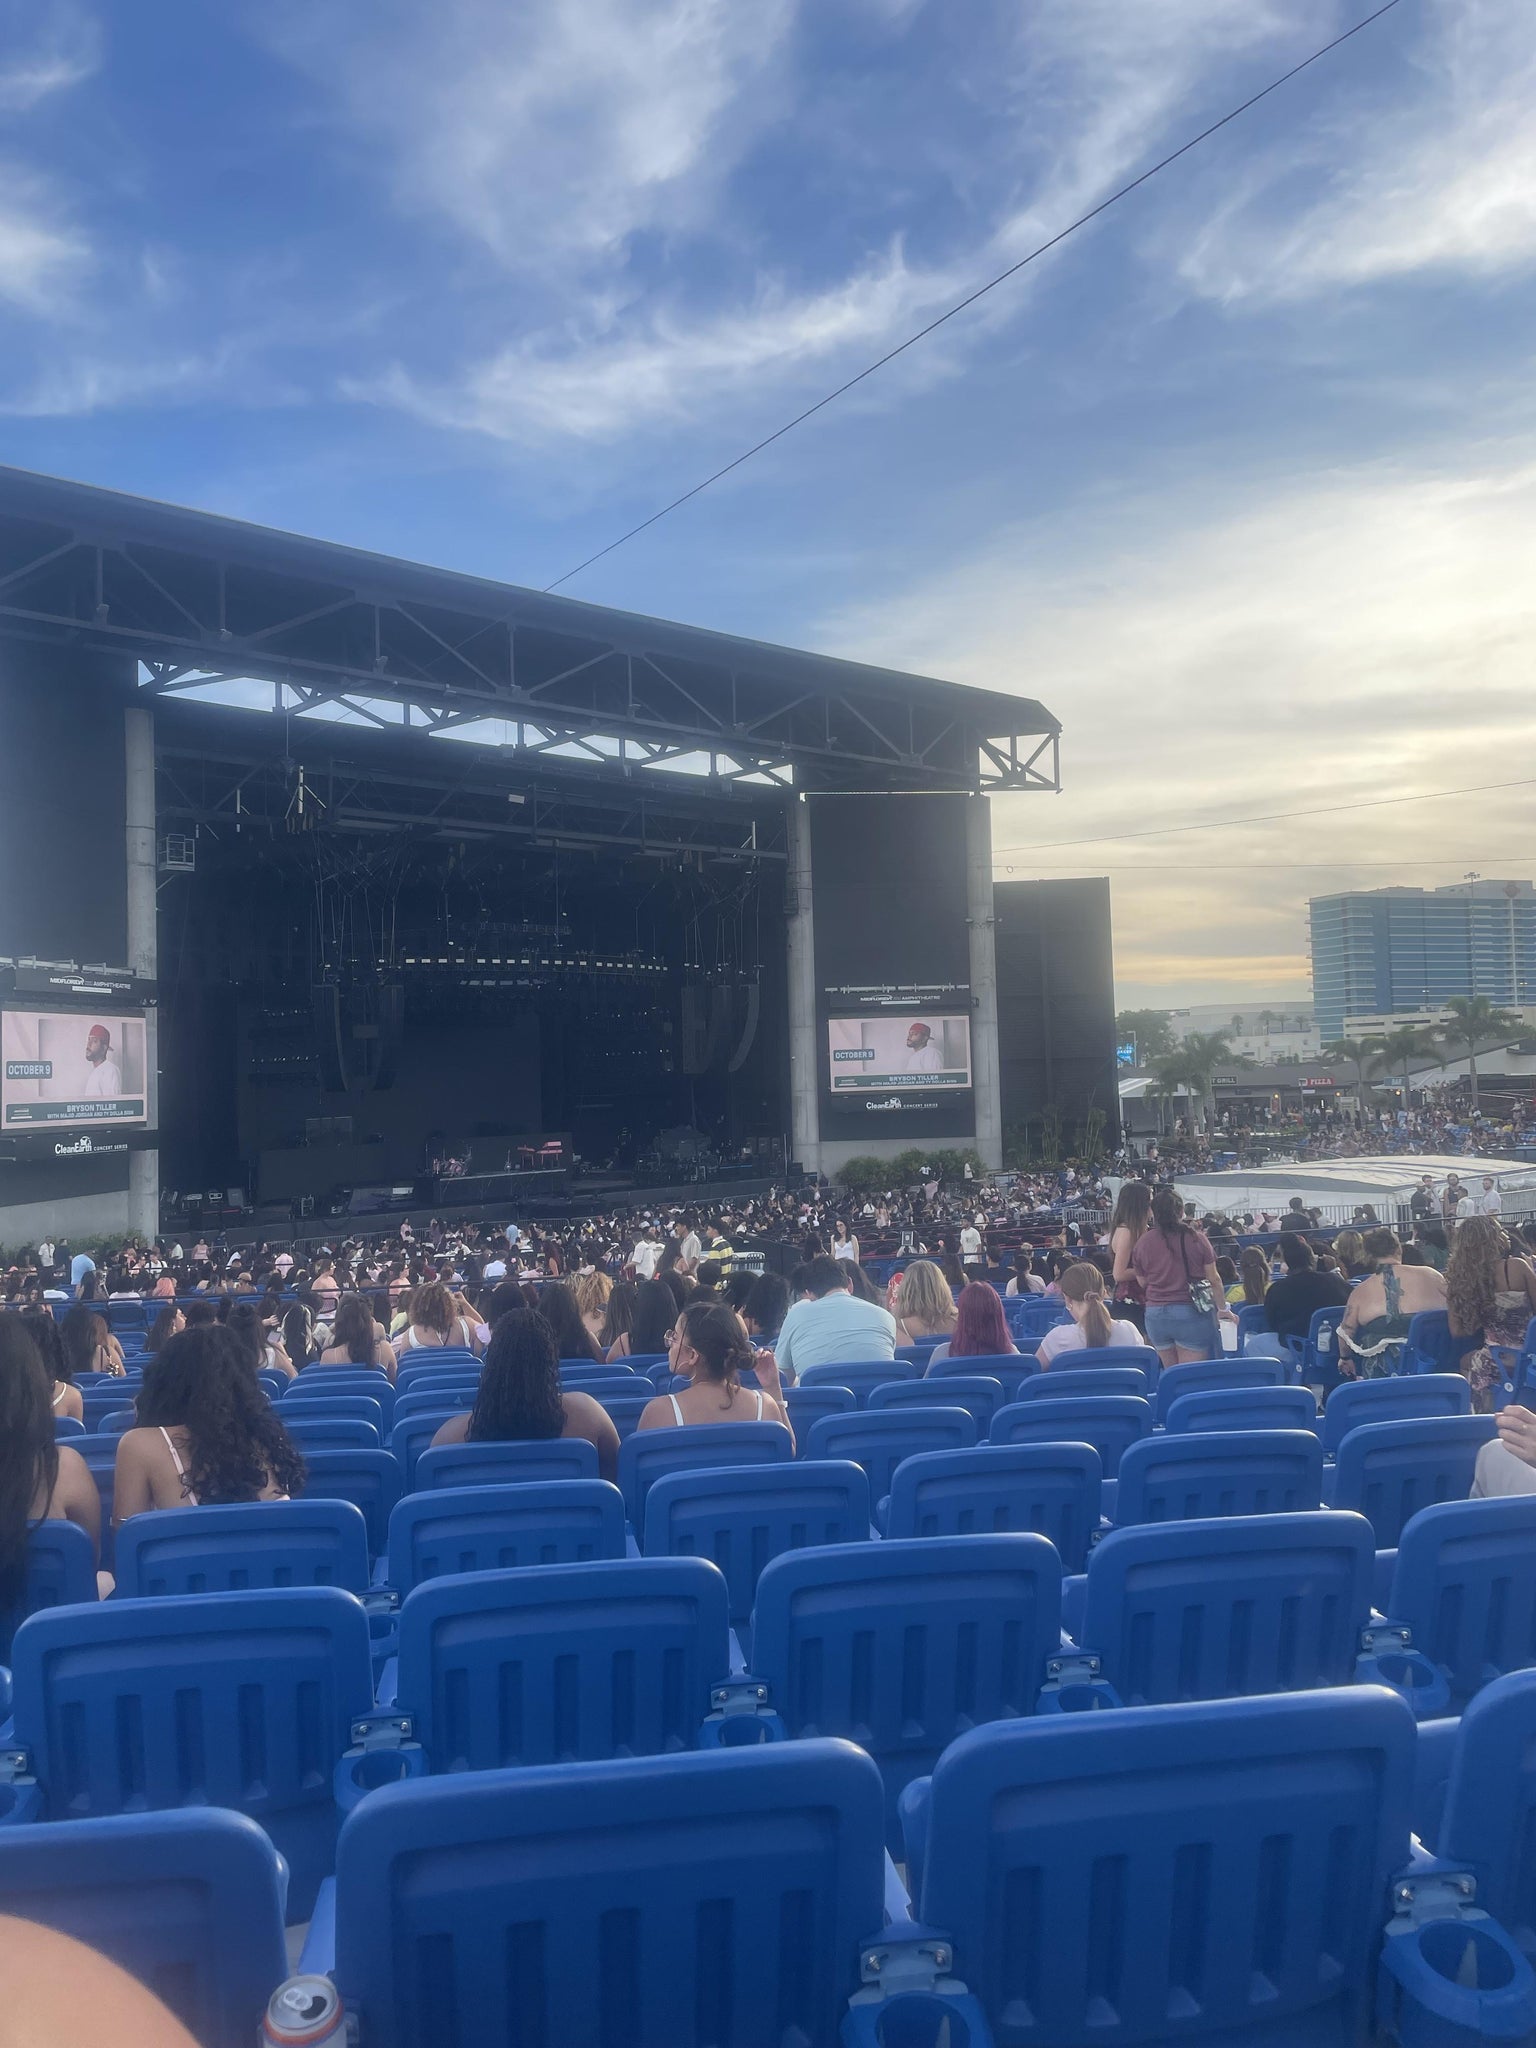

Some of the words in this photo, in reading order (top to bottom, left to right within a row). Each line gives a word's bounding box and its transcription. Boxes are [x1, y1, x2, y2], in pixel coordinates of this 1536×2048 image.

[93, 981, 131, 989] AMPHITHEATRE
[836, 1051, 867, 1059] OCTOBER
[8, 1065, 44, 1075] OCTOBER
[45, 1064, 51, 1075] 9
[1391, 1078, 1402, 1086] BAR
[67, 1104, 94, 1112] BRYSON
[96, 1103, 117, 1111] TILLER
[866, 1101, 901, 1109] CleanEarth
[55, 1142, 92, 1154] CleanEarth
